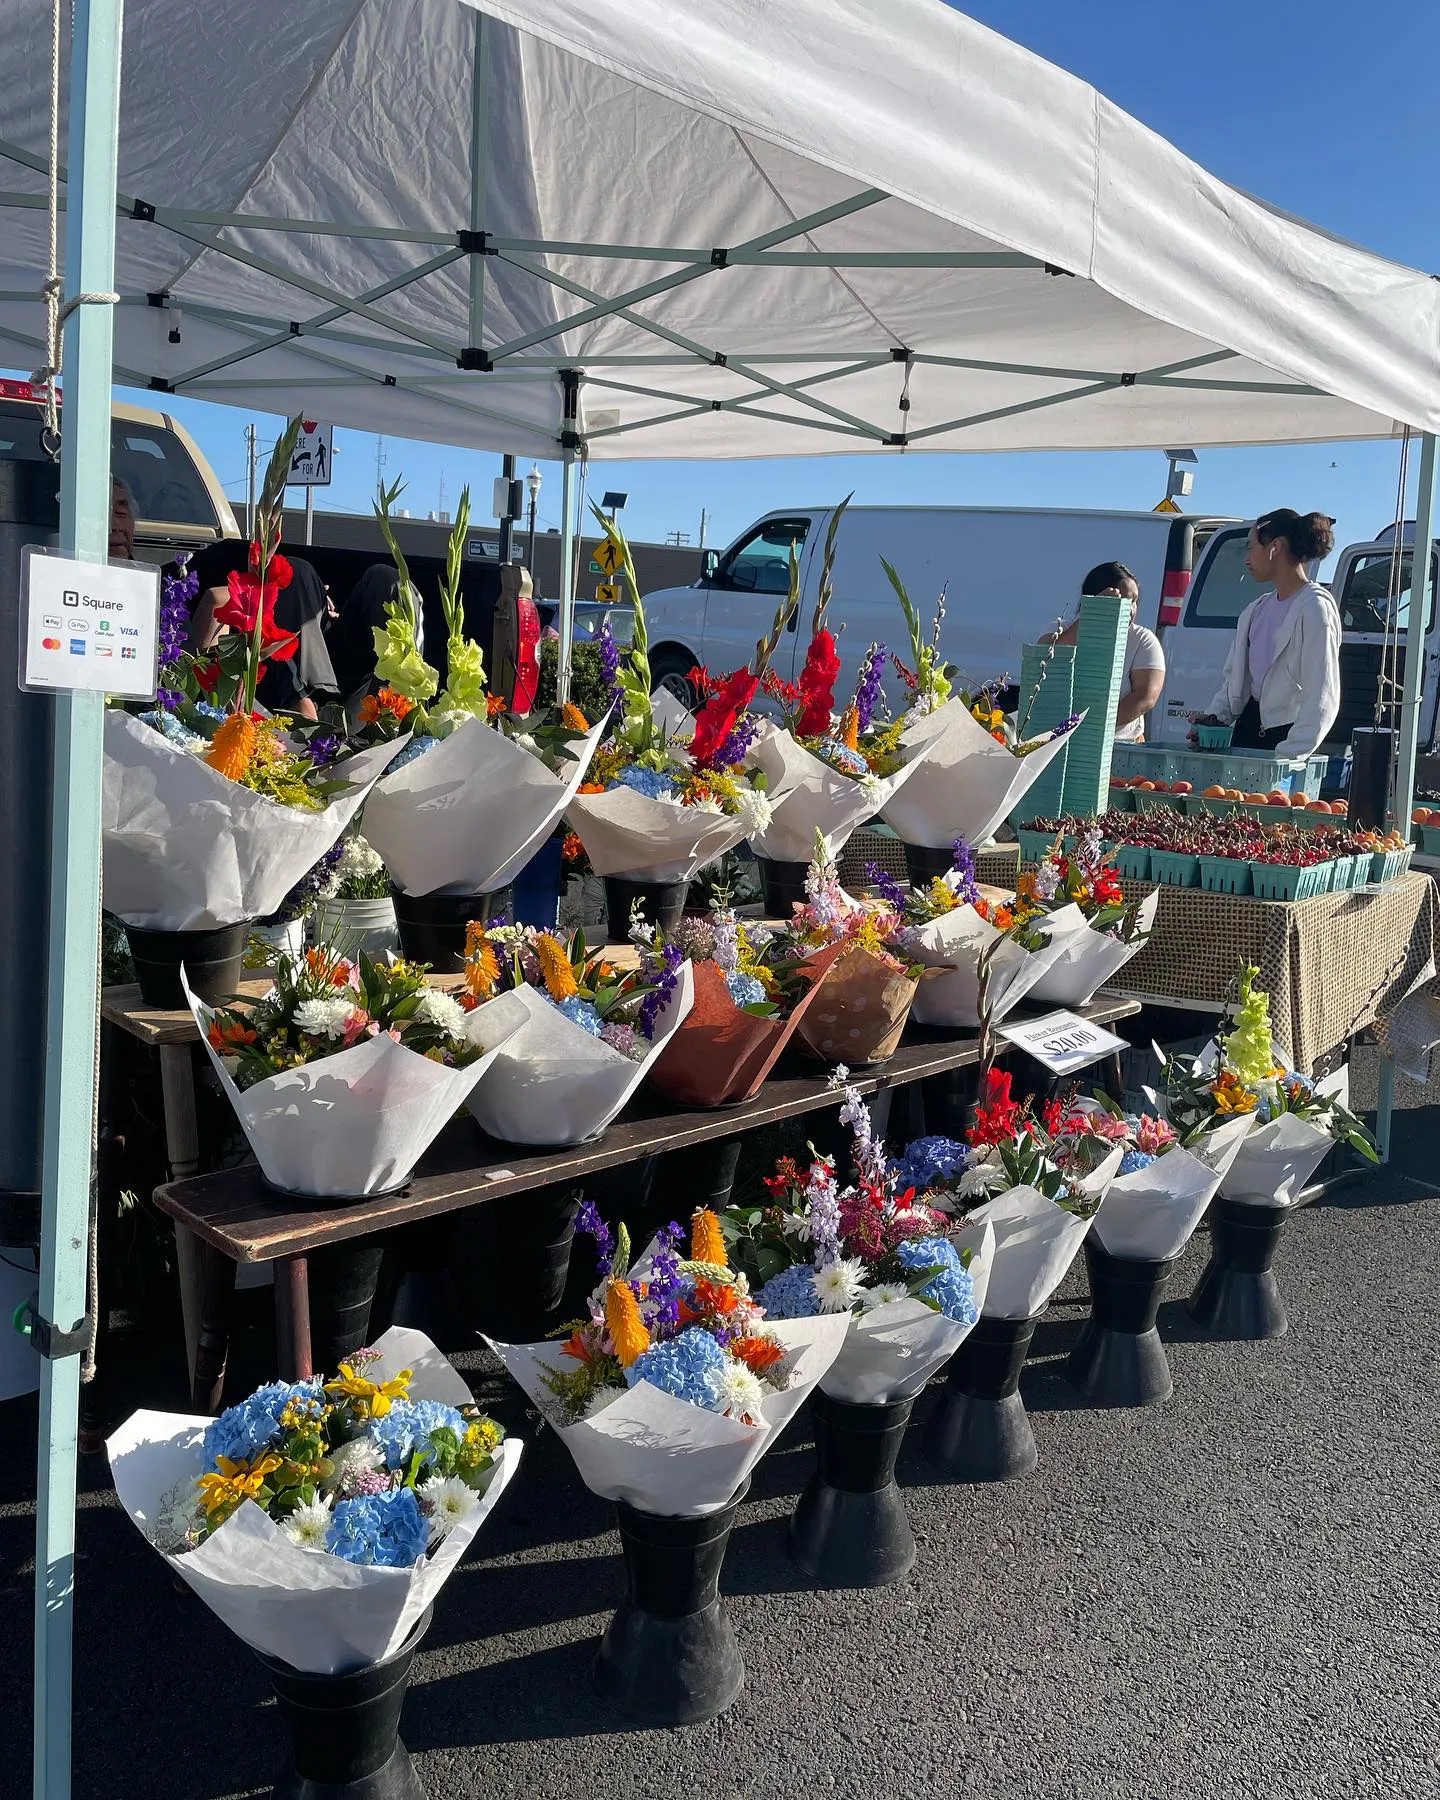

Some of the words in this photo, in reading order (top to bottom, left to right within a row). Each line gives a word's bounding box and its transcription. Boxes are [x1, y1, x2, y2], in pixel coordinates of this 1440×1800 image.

[302, 463, 314, 475] FOR
[82, 595, 123, 611] Square
[120, 627, 139, 636] VISA
[1043, 1030, 1098, 1056] $20.00
